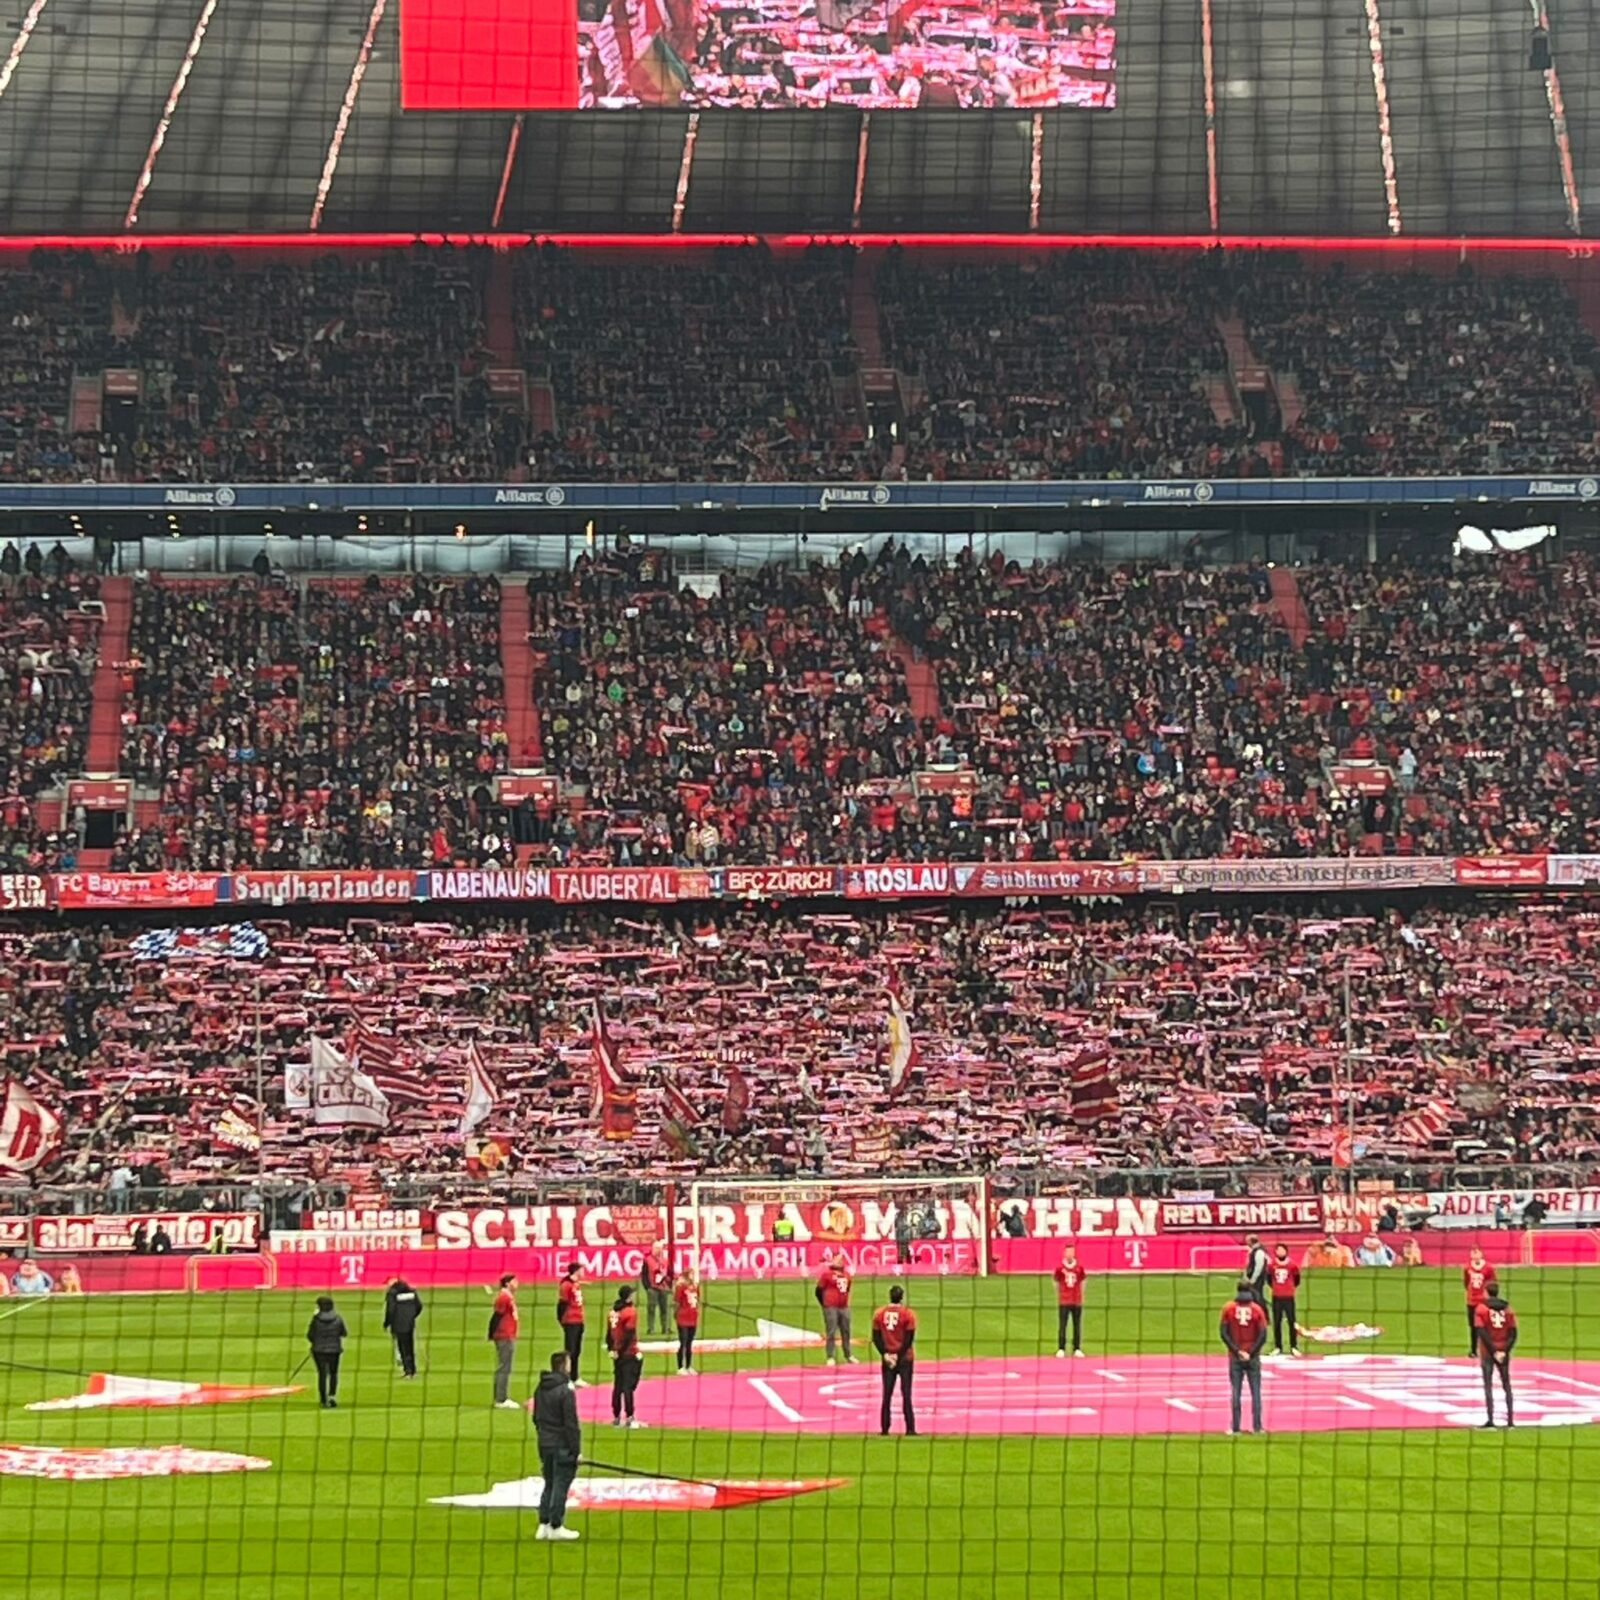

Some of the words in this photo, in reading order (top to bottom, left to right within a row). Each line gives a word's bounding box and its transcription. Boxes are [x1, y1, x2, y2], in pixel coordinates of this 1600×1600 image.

[165, 489, 214, 503] Allianz
[495, 489, 544, 503] Allianz
[822, 488, 869, 501] Allianz
[1144, 486, 1191, 498] Allianz
[1528, 482, 1576, 495] Allianz
[59, 876, 83, 892] FC
[88, 875, 150, 895] Bayern
[235, 875, 411, 901] Sandharlanden
[556, 872, 677, 900] TAUBERTAL
[729, 872, 765, 889] BFC
[436, 1203, 812, 1249] SCHICERIA
[723, 1246, 808, 1274] MOBIL
[1124, 1240, 1147, 1268] T
[884, 1311, 899, 1331] T
[1235, 1307, 1252, 1326] T
